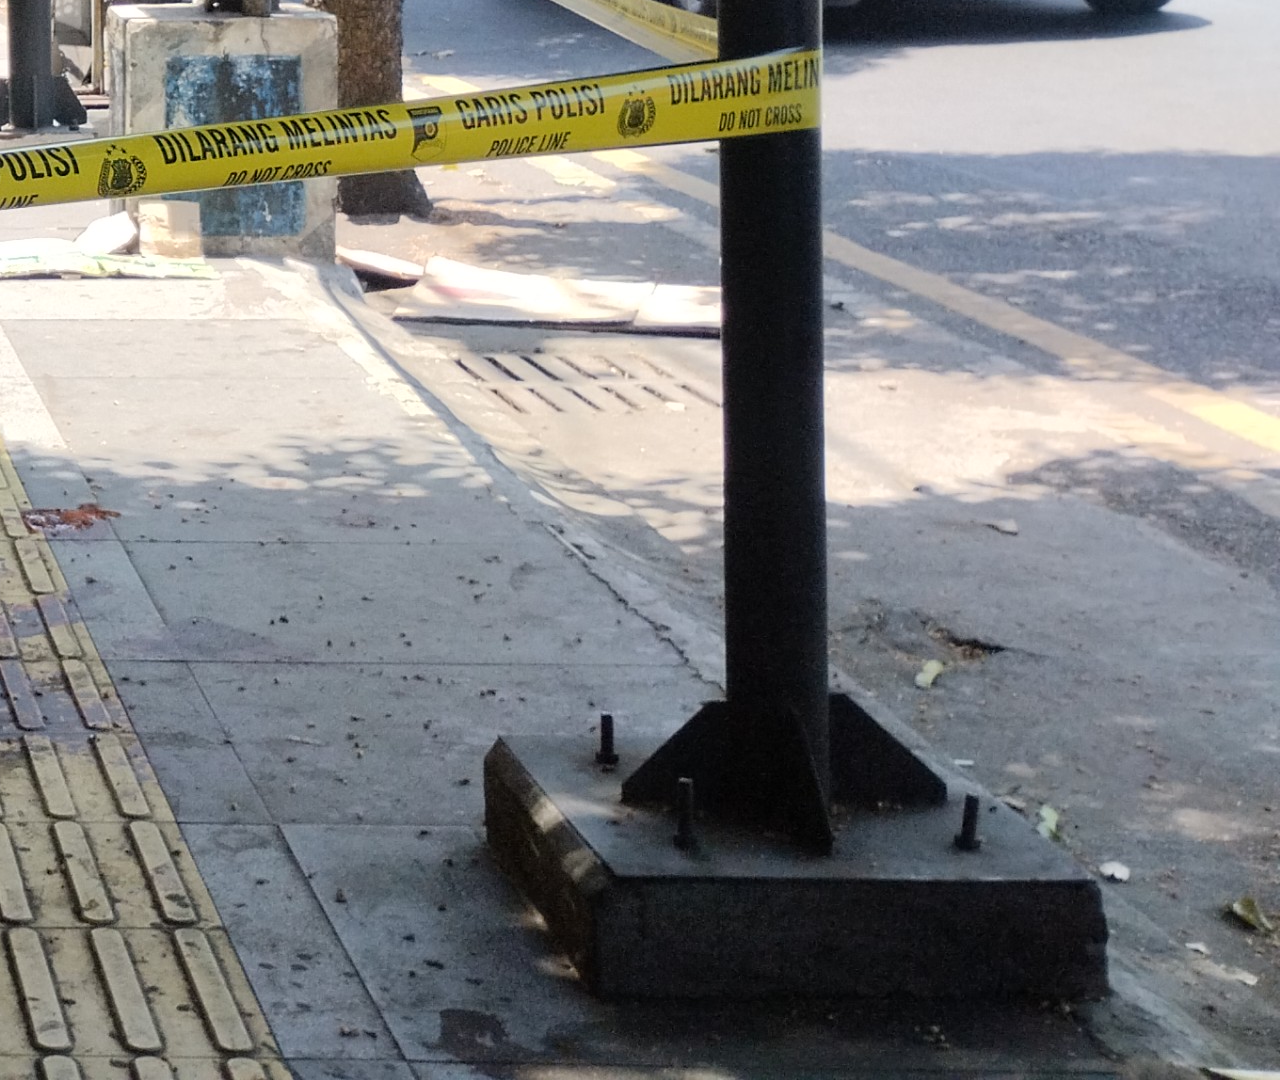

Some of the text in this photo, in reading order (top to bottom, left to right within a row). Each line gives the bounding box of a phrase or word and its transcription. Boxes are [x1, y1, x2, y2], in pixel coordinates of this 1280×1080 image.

[667, 57, 820, 105] DILARANG MELIN
[454, 83, 606, 130] GARIS POLISI
[719, 103, 803, 132] DO NOT CROSS
[152, 108, 398, 165] DILARANG MELINTAS
[485, 131, 571, 158] POLICE LINE
[223, 160, 332, 186] DO NOT CROSS
